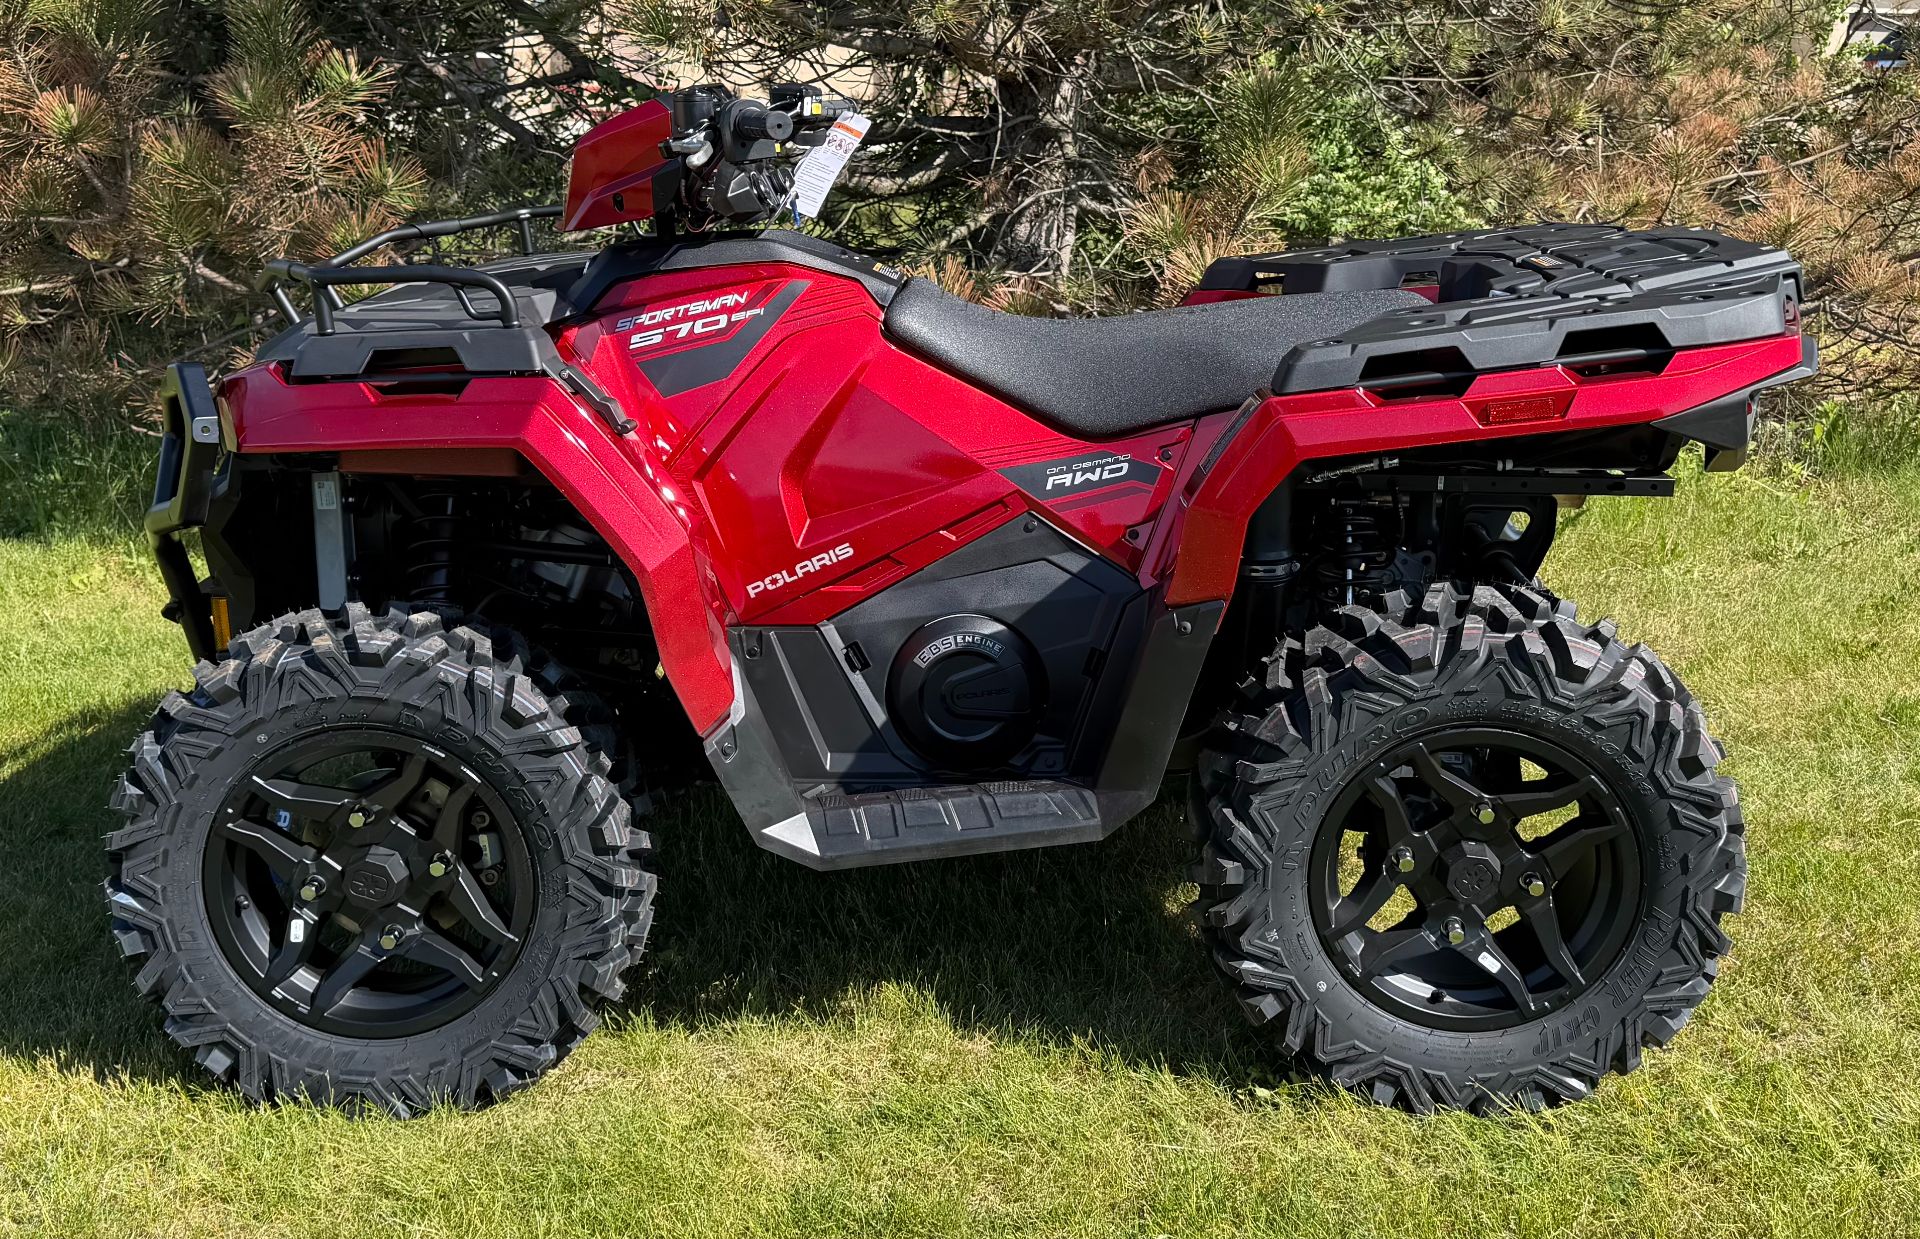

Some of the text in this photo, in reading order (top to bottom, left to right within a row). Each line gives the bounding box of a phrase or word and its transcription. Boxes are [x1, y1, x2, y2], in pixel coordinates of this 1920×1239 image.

[615, 291, 749, 332] SPORTSMAN
[629, 314, 729, 350] 570
[1045, 462, 1129, 491] AWD
[1046, 453, 1131, 475] ON DEMAND
[746, 542, 854, 599] POLARIS
[917, 637, 954, 664] EBS
[956, 635, 1002, 652] ENGINE
[1606, 905, 1674, 1010] POWER
[1531, 1003, 1602, 1058] GRIP
